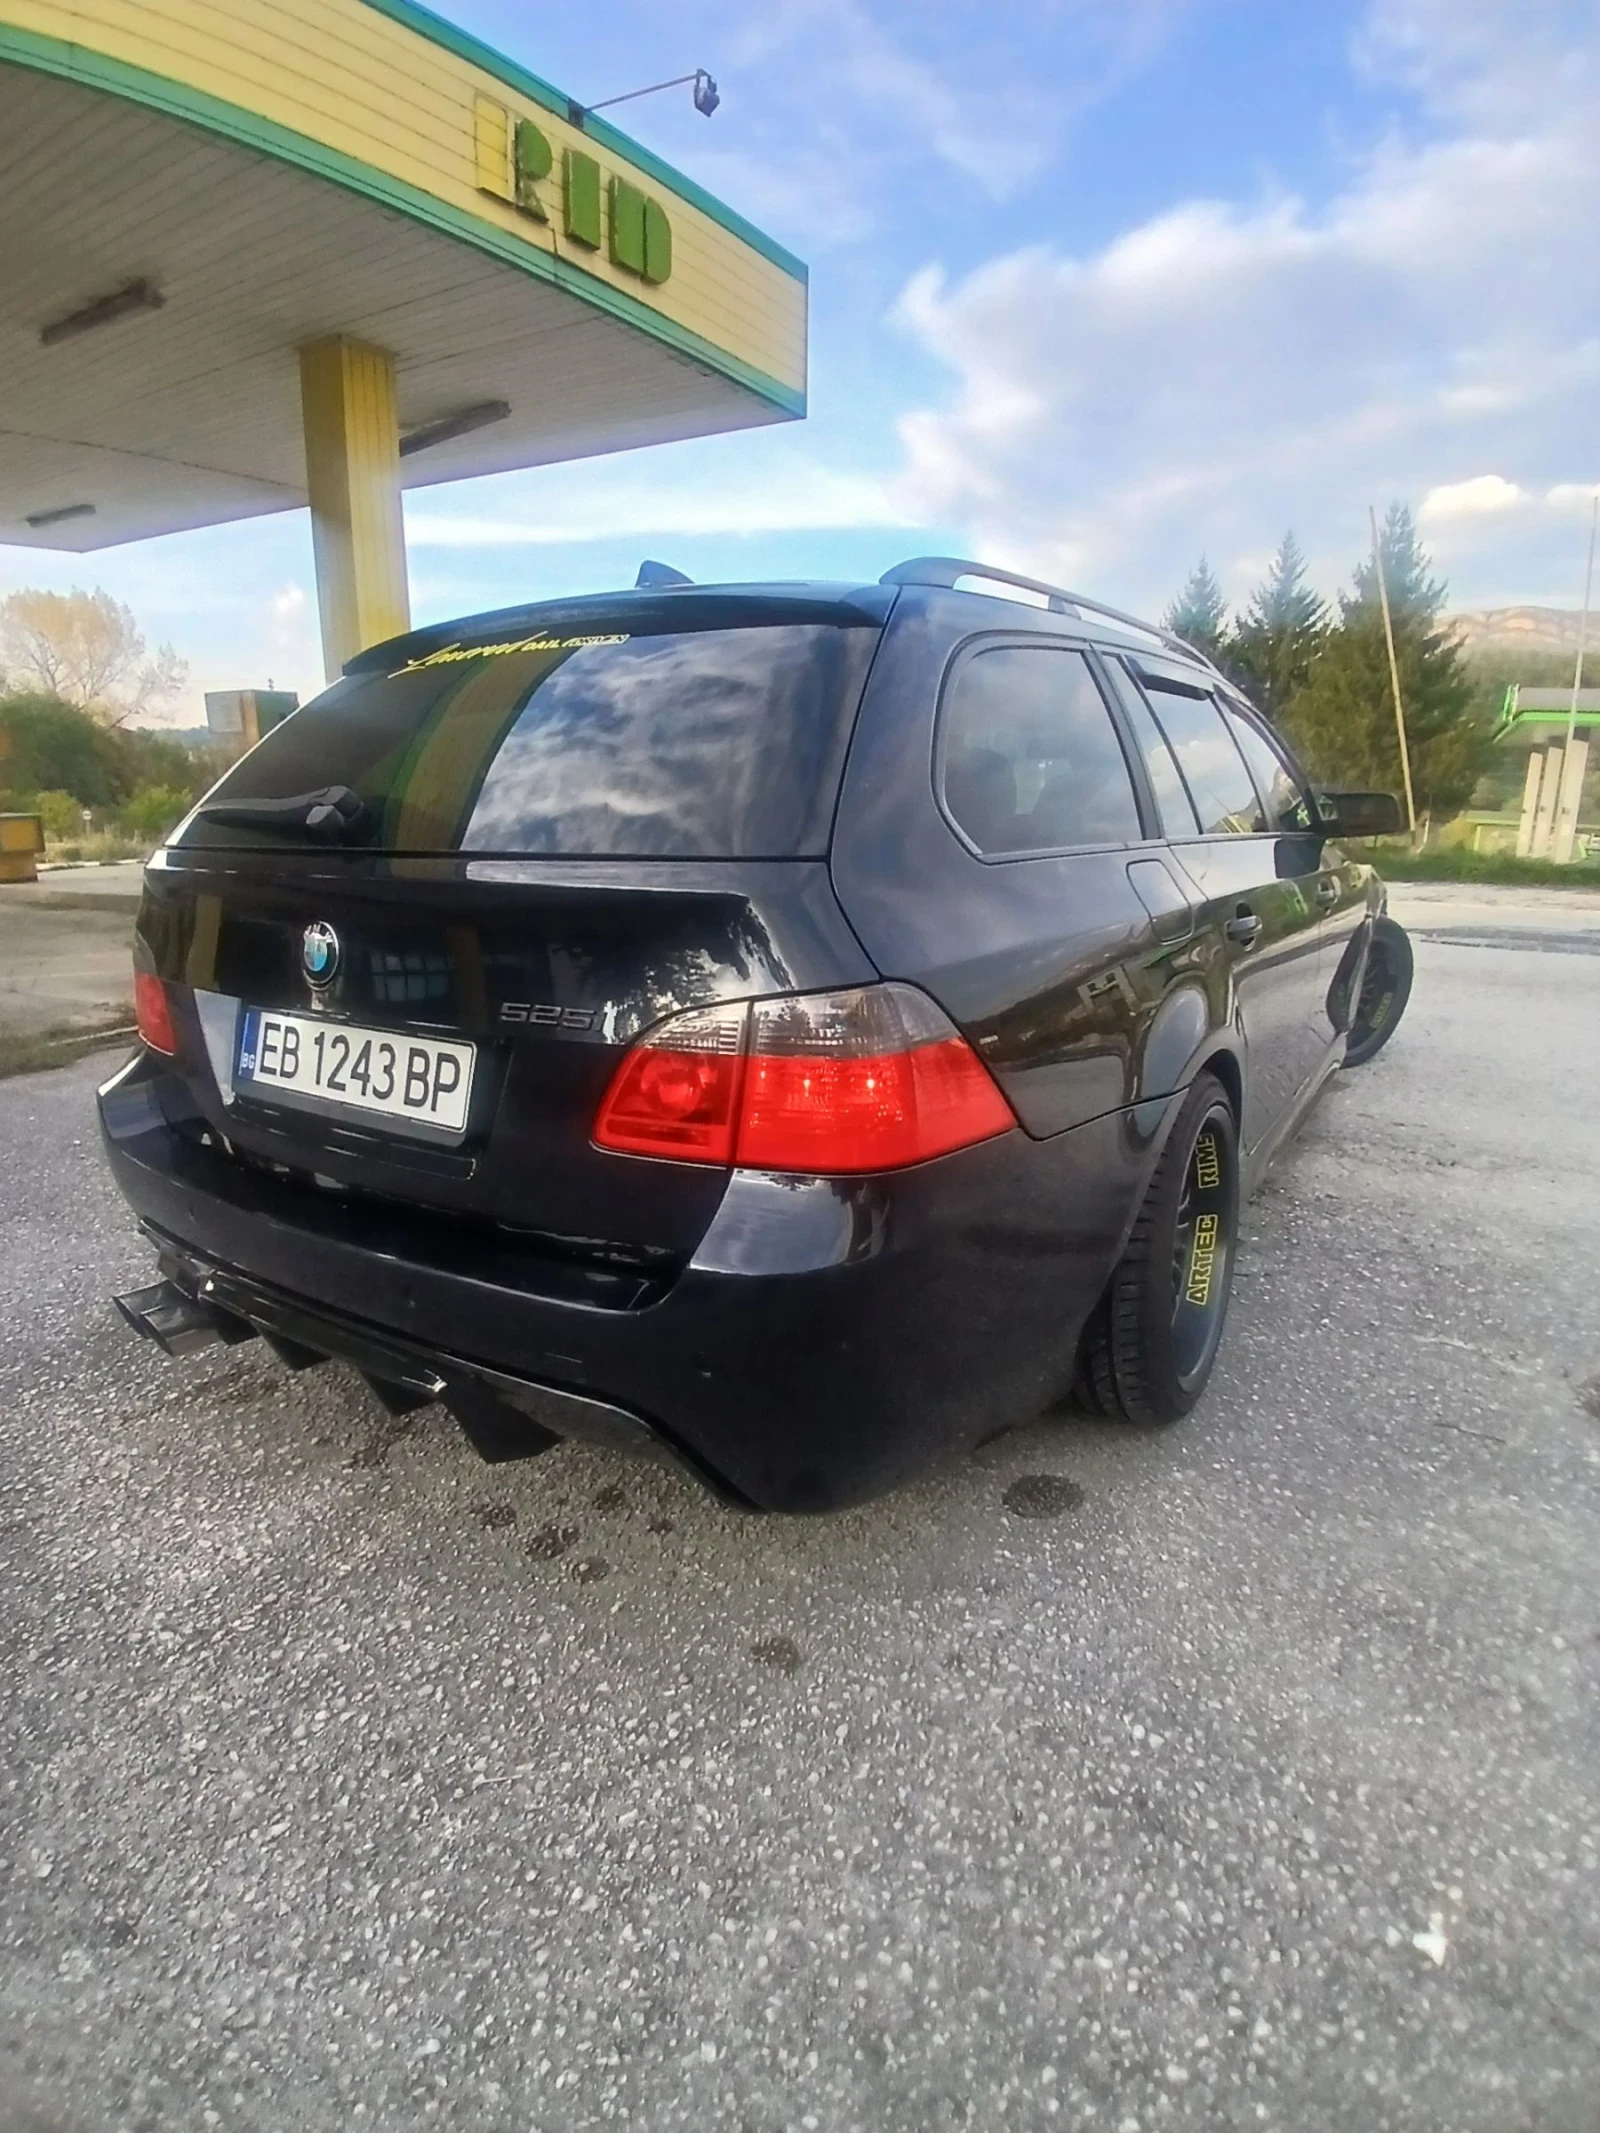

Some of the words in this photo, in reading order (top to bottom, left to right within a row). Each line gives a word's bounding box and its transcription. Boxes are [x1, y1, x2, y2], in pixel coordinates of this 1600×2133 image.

[241, 1052, 256, 1070] BG
[259, 1021, 301, 1079] EB
[314, 1031, 396, 1100] 1243
[403, 1046, 461, 1112] BP
[1196, 1132, 1220, 1189] RIMS
[1186, 1213, 1219, 1306] ARTEC
